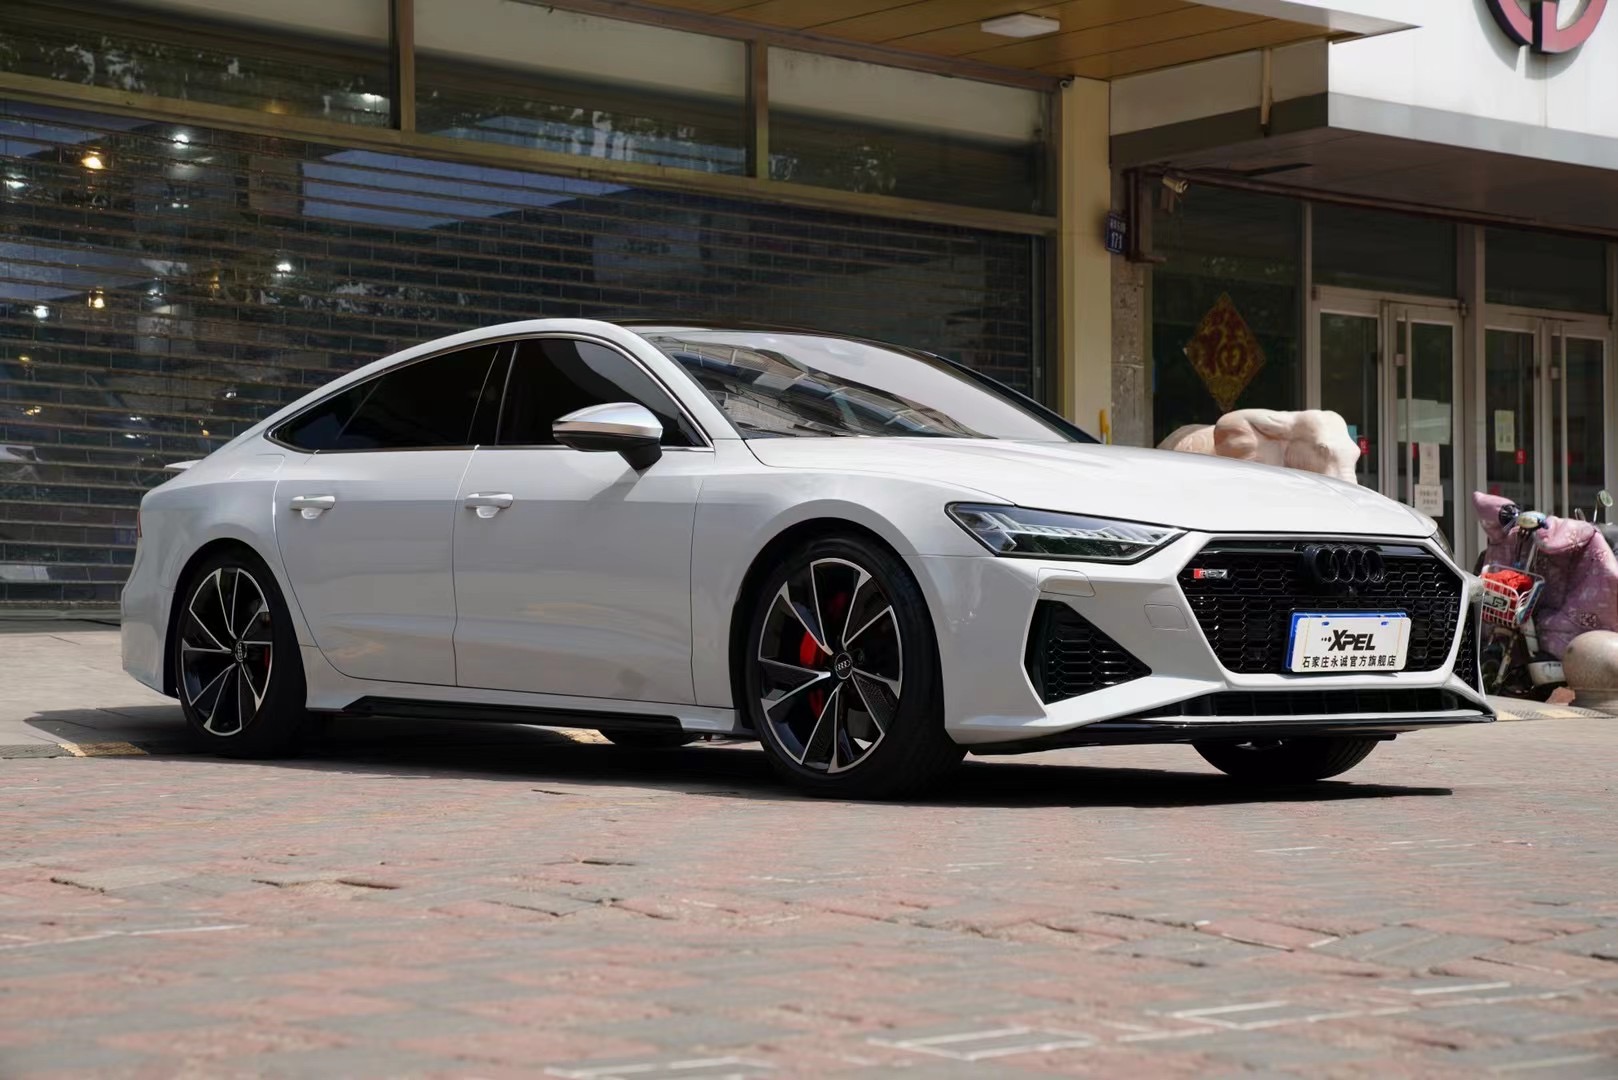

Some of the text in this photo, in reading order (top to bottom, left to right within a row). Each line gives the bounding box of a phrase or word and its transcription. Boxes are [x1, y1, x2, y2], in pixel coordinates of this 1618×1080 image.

[1327, 629, 1377, 651] XPEL
[1302, 655, 1397, 668] 石家庄永诚官方旗舰店
